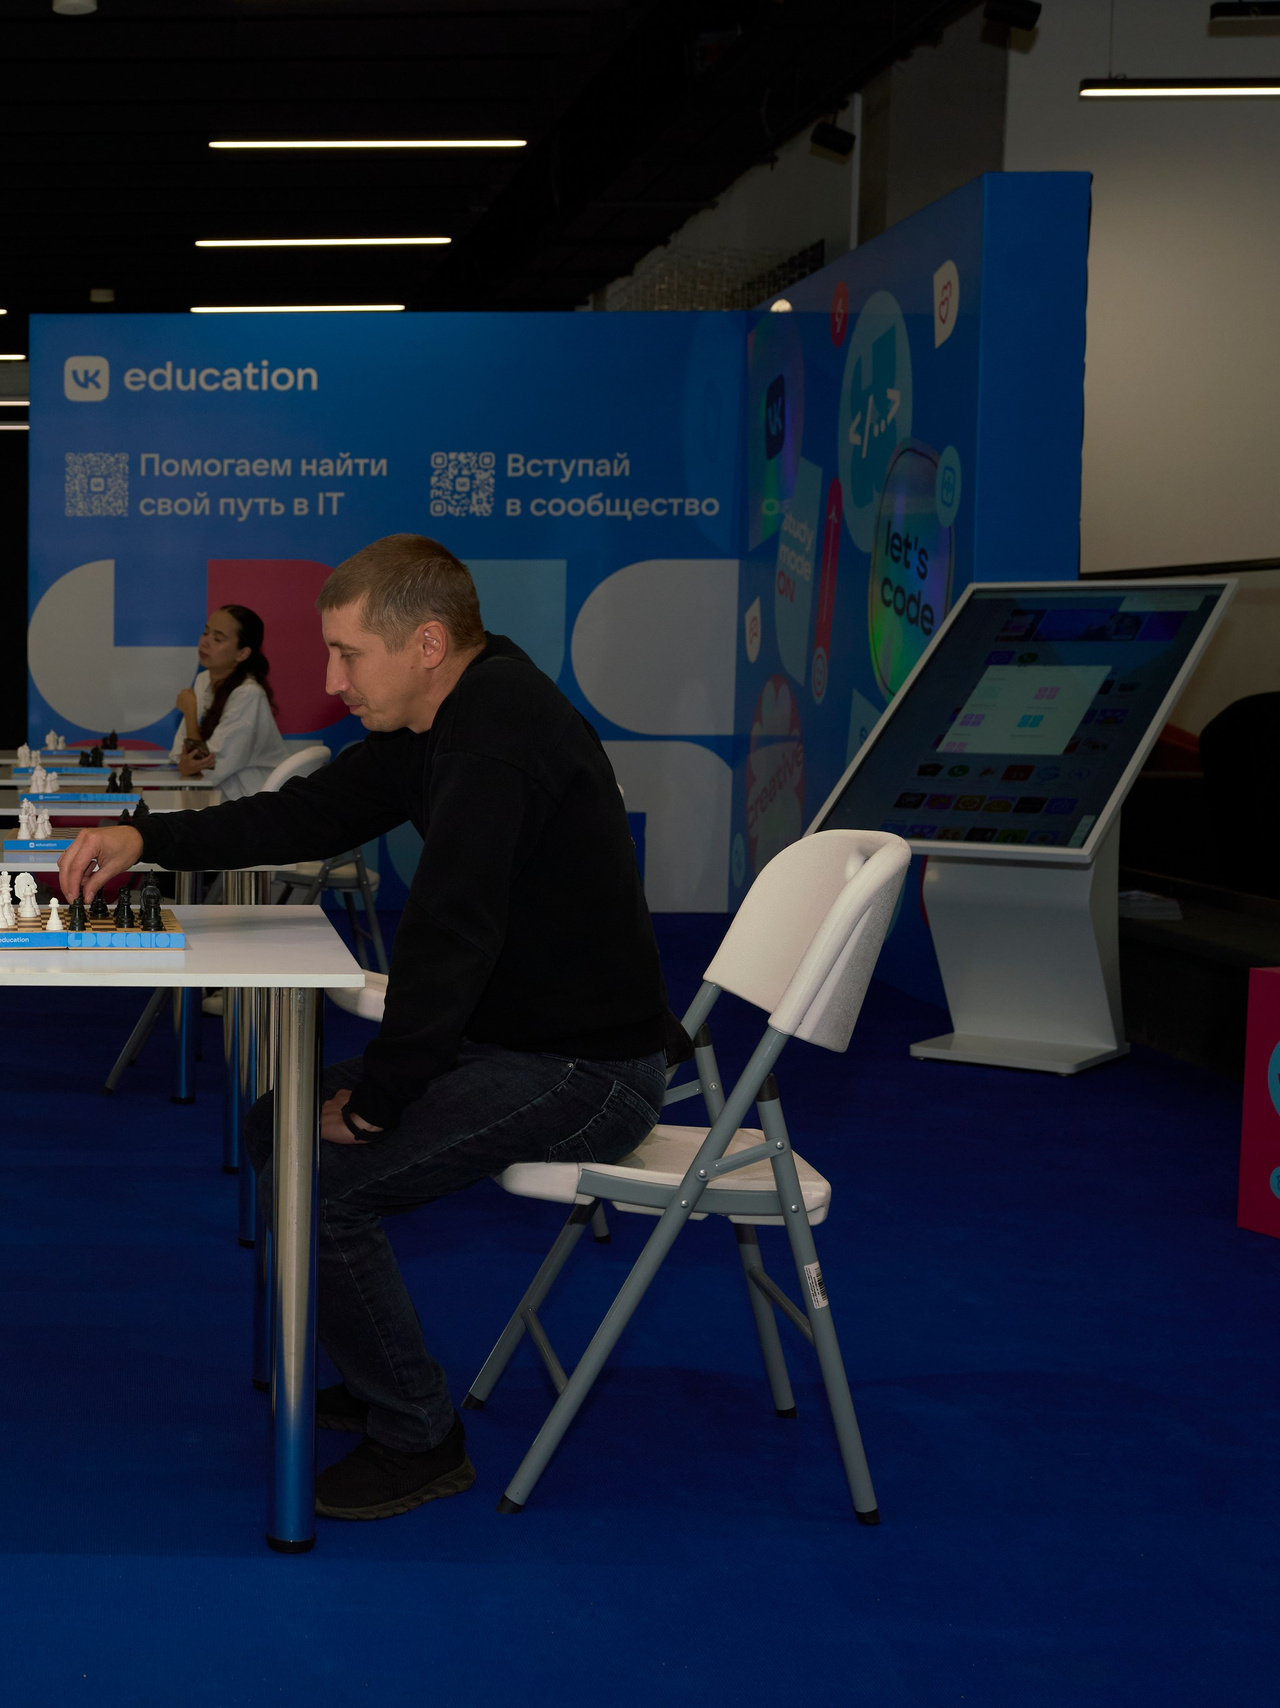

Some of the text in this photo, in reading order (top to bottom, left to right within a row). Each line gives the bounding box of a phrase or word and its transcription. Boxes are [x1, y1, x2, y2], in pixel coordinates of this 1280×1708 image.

[124, 359, 318, 391] education
[140, 451, 388, 477] Помогаем найти
[507, 452, 630, 483] Вступай
[139, 492, 345, 522] свой путь в IT
[506, 493, 719, 520] в сообщество
[781, 513, 813, 552] study
[778, 543, 811, 581] mode
[884, 519, 928, 580] let's
[776, 571, 795, 603] ON
[881, 577, 934, 636] code
[748, 740, 803, 831] creative
